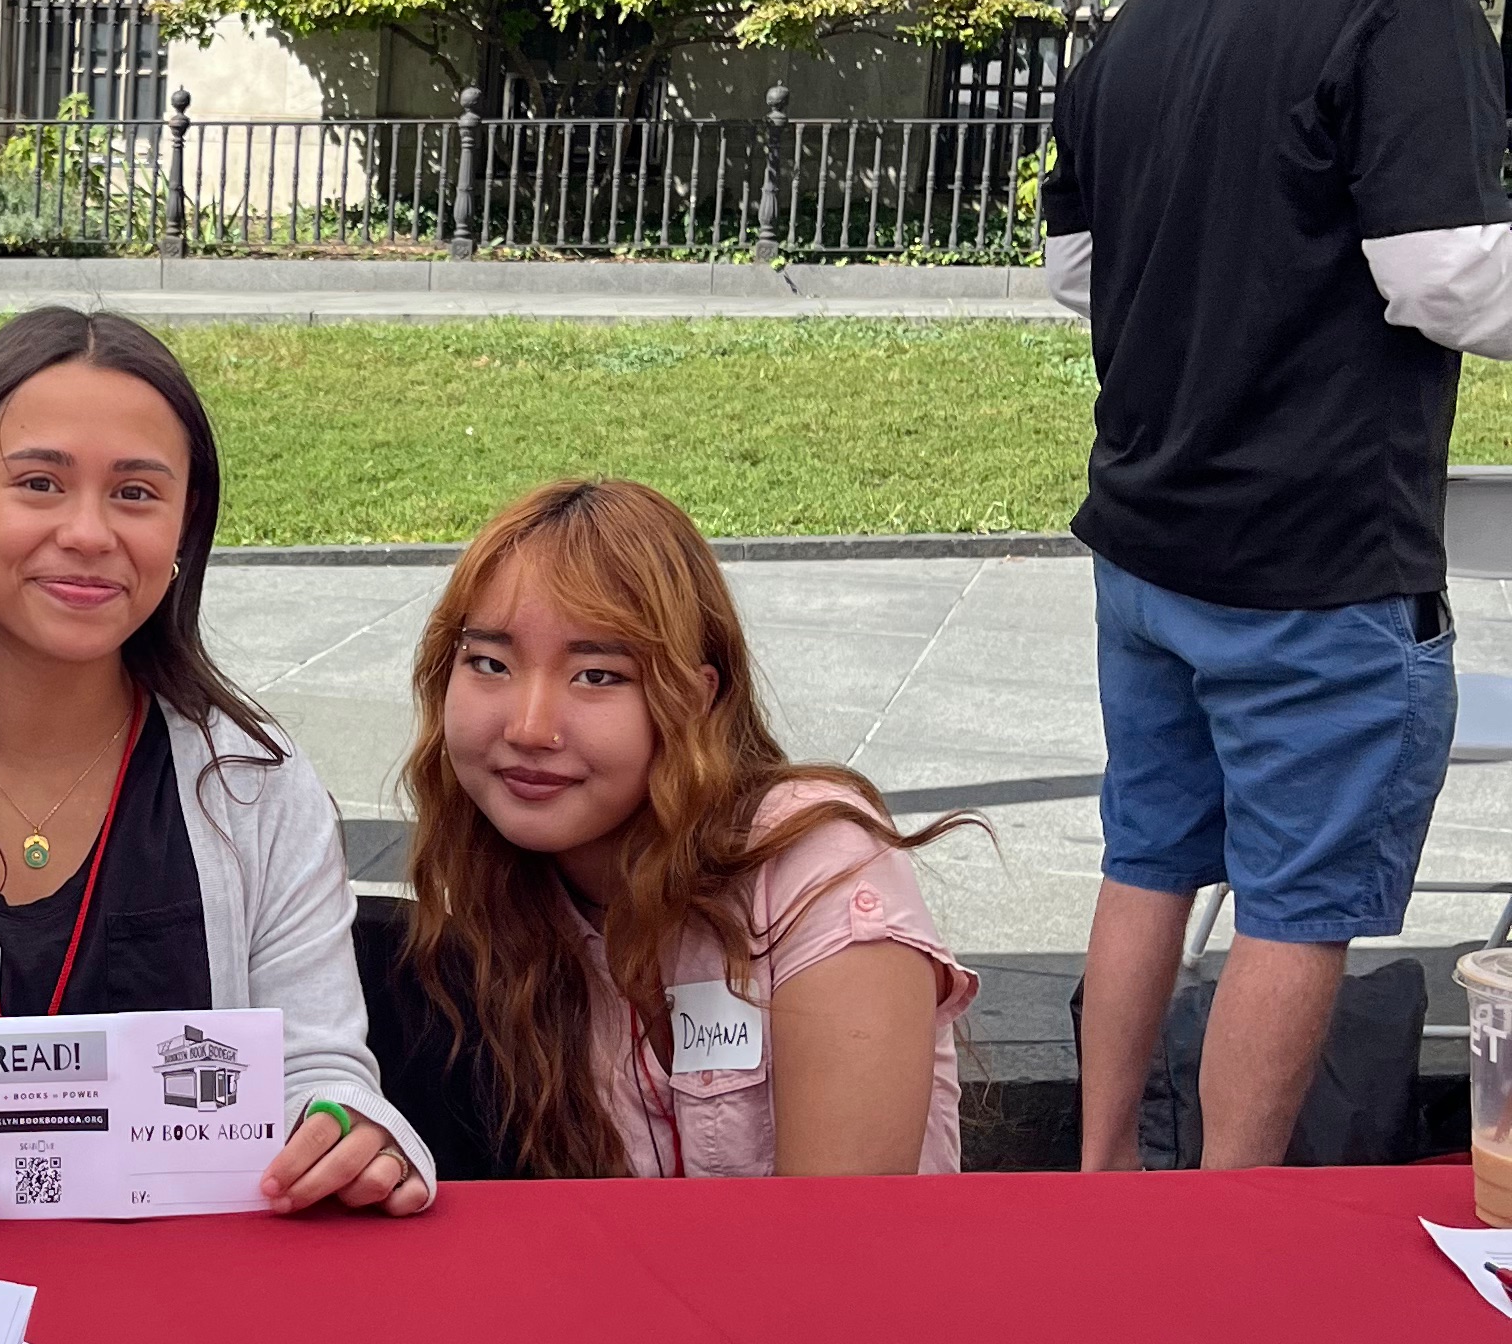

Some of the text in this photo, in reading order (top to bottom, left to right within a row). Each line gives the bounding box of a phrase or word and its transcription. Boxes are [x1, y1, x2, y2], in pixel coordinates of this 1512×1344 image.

[680, 1012, 748, 1056] DAYANA
[13, 1092, 49, 1100] BOOKS
[62, 1090, 99, 1099] POWER
[131, 1123, 275, 1142] MY BOOK ABOUT
[132, 1191, 151, 1204] BY:
